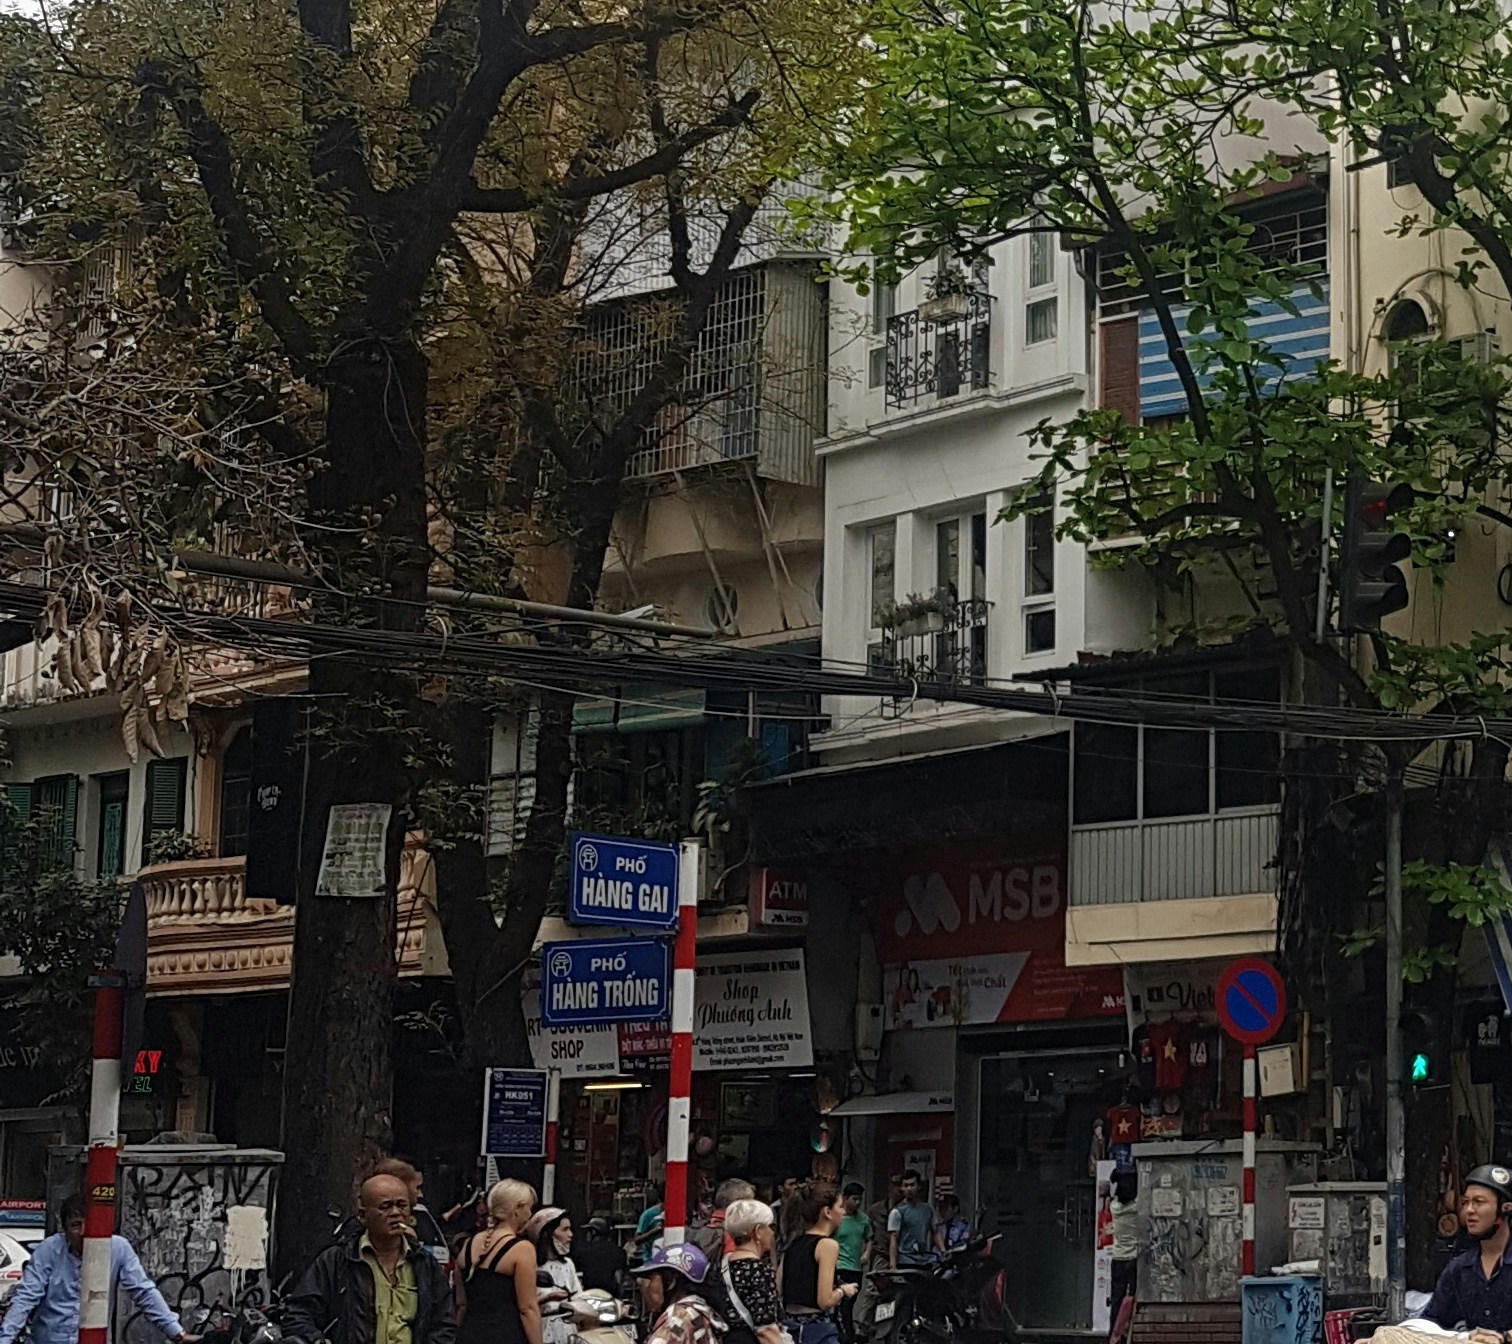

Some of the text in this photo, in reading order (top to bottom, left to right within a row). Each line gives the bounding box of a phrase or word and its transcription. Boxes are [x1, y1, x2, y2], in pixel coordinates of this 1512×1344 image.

[615, 855, 648, 874] PHỐ
[581, 872, 669, 914] HÀNG GAI
[769, 880, 807, 901] ATM
[968, 866, 1060, 925] MSB
[590, 951, 627, 972] PHỐ
[552, 970, 659, 1010] HÀNG TRỐNG
[722, 978, 759, 1004] Shop
[757, 998, 793, 1022] Anh
[551, 1039, 584, 1059] SHOP
